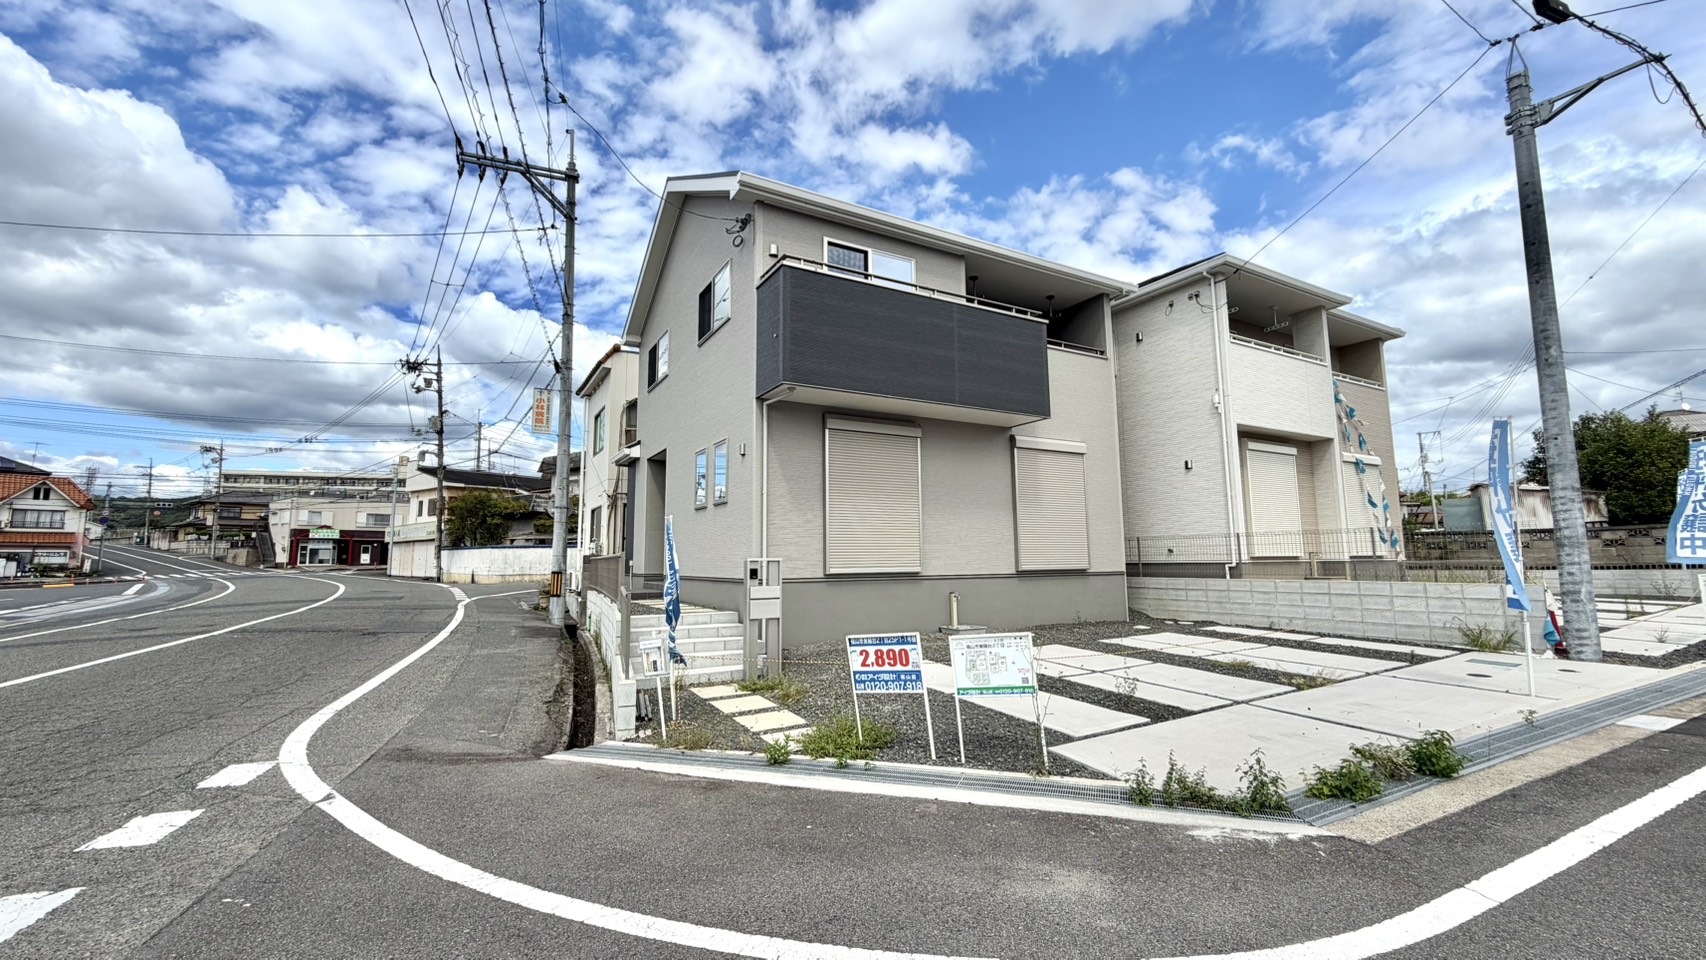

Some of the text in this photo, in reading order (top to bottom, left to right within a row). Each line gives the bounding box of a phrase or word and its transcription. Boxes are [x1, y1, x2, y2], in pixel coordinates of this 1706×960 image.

[535, 398, 545, 425] 小林病院
[859, 648, 910, 668] 2,890
